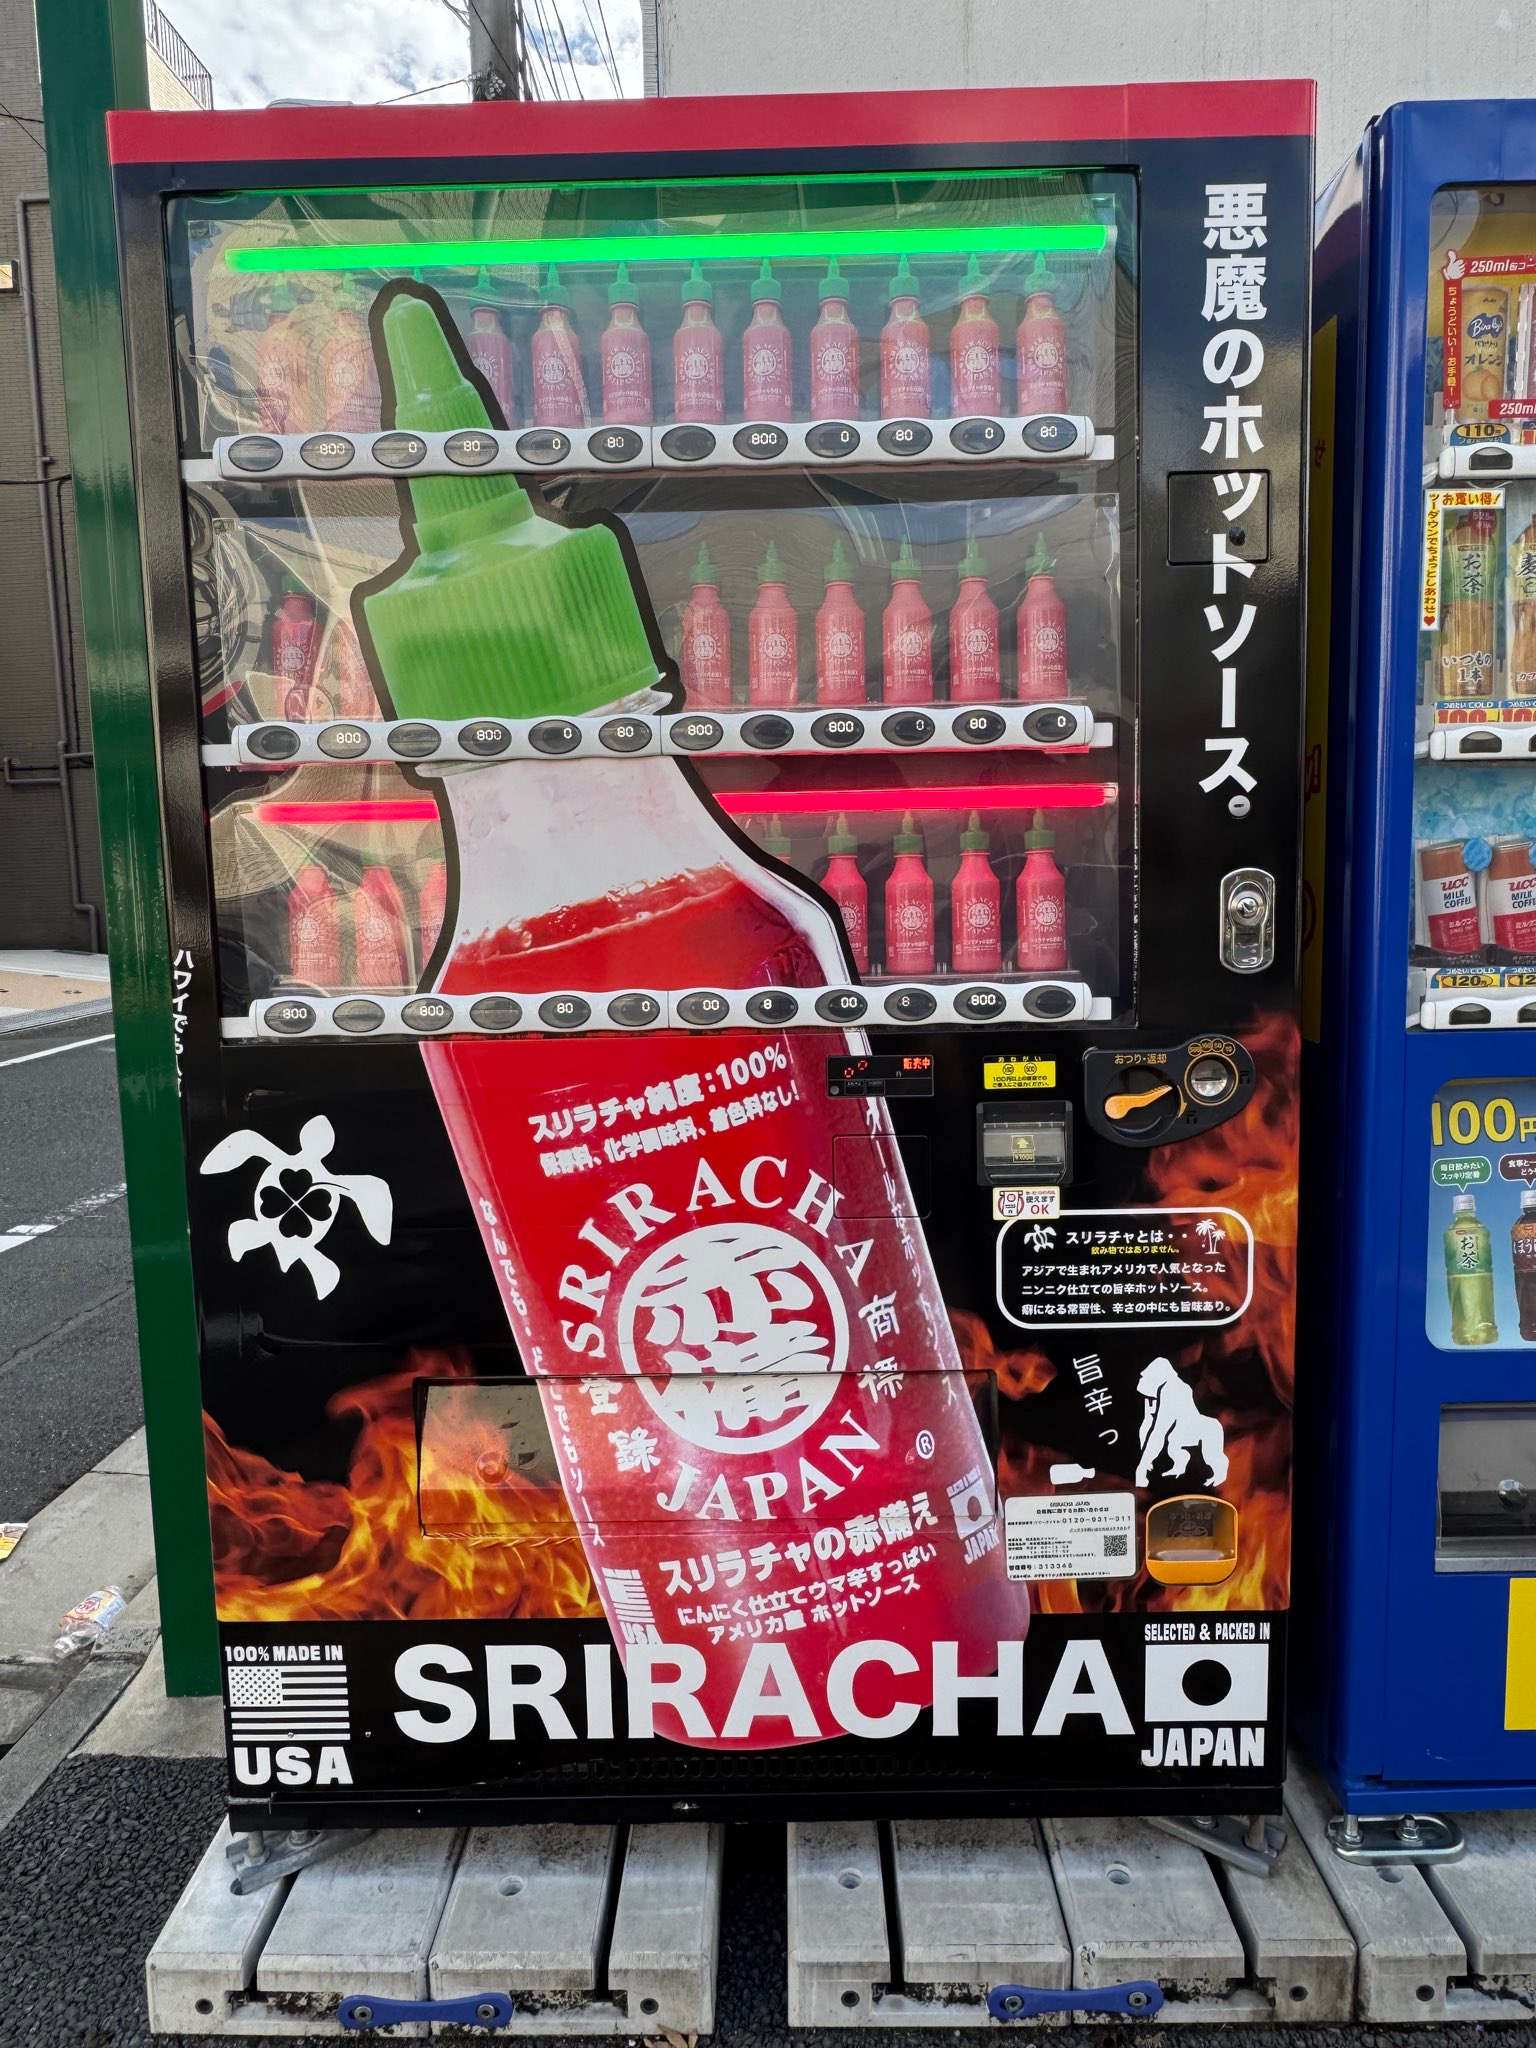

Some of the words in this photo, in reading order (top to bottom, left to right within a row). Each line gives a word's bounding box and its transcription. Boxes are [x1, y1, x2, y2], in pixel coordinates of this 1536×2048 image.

[840, 431, 849, 443] 0
[895, 429, 913, 441] 80
[985, 428, 994, 439] 0
[1040, 426, 1057, 437] 80
[552, 438, 561, 450] 0
[607, 436, 624, 448] 80
[751, 432, 777, 444] 800
[319, 443, 345, 455] 800
[408, 441, 417, 453] 0
[462, 440, 480, 452] 80
[1442, 491, 1501, 506] お買い得!
[1462, 552, 1485, 594] お茶
[1442, 651, 1492, 667] いつもの
[1458, 667, 1484, 682] 1本
[829, 721, 854, 733] 800
[916, 720, 924, 731] 0
[970, 718, 987, 729] 80
[1057, 716, 1066, 727] 0
[476, 729, 501, 741] 800
[563, 728, 572, 739] 0
[617, 726, 634, 738] 80
[688, 725, 713, 736] 800
[336, 732, 361, 744] 800
[1440, 876, 1469, 892] UCC
[1443, 889, 1465, 901] MILK
[1511, 889, 1533, 901] MILK
[702, 999, 719, 1011] 00
[763, 998, 772, 1010] 8
[840, 997, 857, 1008] 00
[902, 996, 910, 1007] 8
[971, 994, 996, 1006] 800
[419, 1005, 444, 1016] 800
[557, 1002, 573, 1014] 80
[641, 1001, 650, 1012] 0
[283, 1008, 307, 1019] 800
[903, 1057, 930, 1070] 販売中
[1113, 1053, 1167, 1065] おつり・返却
[1440, 1162, 1485, 1172] 毎日飲みたい
[1031, 1204, 1050, 1215] OK
[1091, 1245, 1180, 1255] 飲み物ではありません。
[1461, 1236, 1479, 1269] お茶
[558, 1155, 876, 1358] SRIRACHA
[1022, 1262, 1227, 1276] アジアで生まれアメリカで人気となった
[1022, 1282, 1209, 1296] ニンニク仕立ての旨辛ホットソース。
[1022, 1301, 1232, 1316] 癖になる常習性、辛さの中にも旨味あり。
[1072, 1353, 1119, 1445] 旨辛っ
[656, 1409, 882, 1522] JAPAN
[659, 1491, 939, 1596] スリラチャの赤備え
[963, 1523, 1001, 1565] JAPAN
[677, 1542, 938, 1627] にんにく仕立てウマ辛すっぱい
[810, 1572, 921, 1624] ホットソース
[620, 1621, 664, 1645] USA
[1144, 1623, 1196, 1641] SELECTED
[1199, 1623, 1213, 1640] &
[1214, 1622, 1256, 1640] PACKED
[1258, 1622, 1271, 1640] IN
[224, 1646, 270, 1662] 100%
[273, 1645, 322, 1662] MADE
[325, 1645, 344, 1661] IN
[393, 1639, 1136, 1743] SRIRACHA
[1141, 1727, 1265, 1768] JAPAN
[233, 1746, 354, 1786] USA
